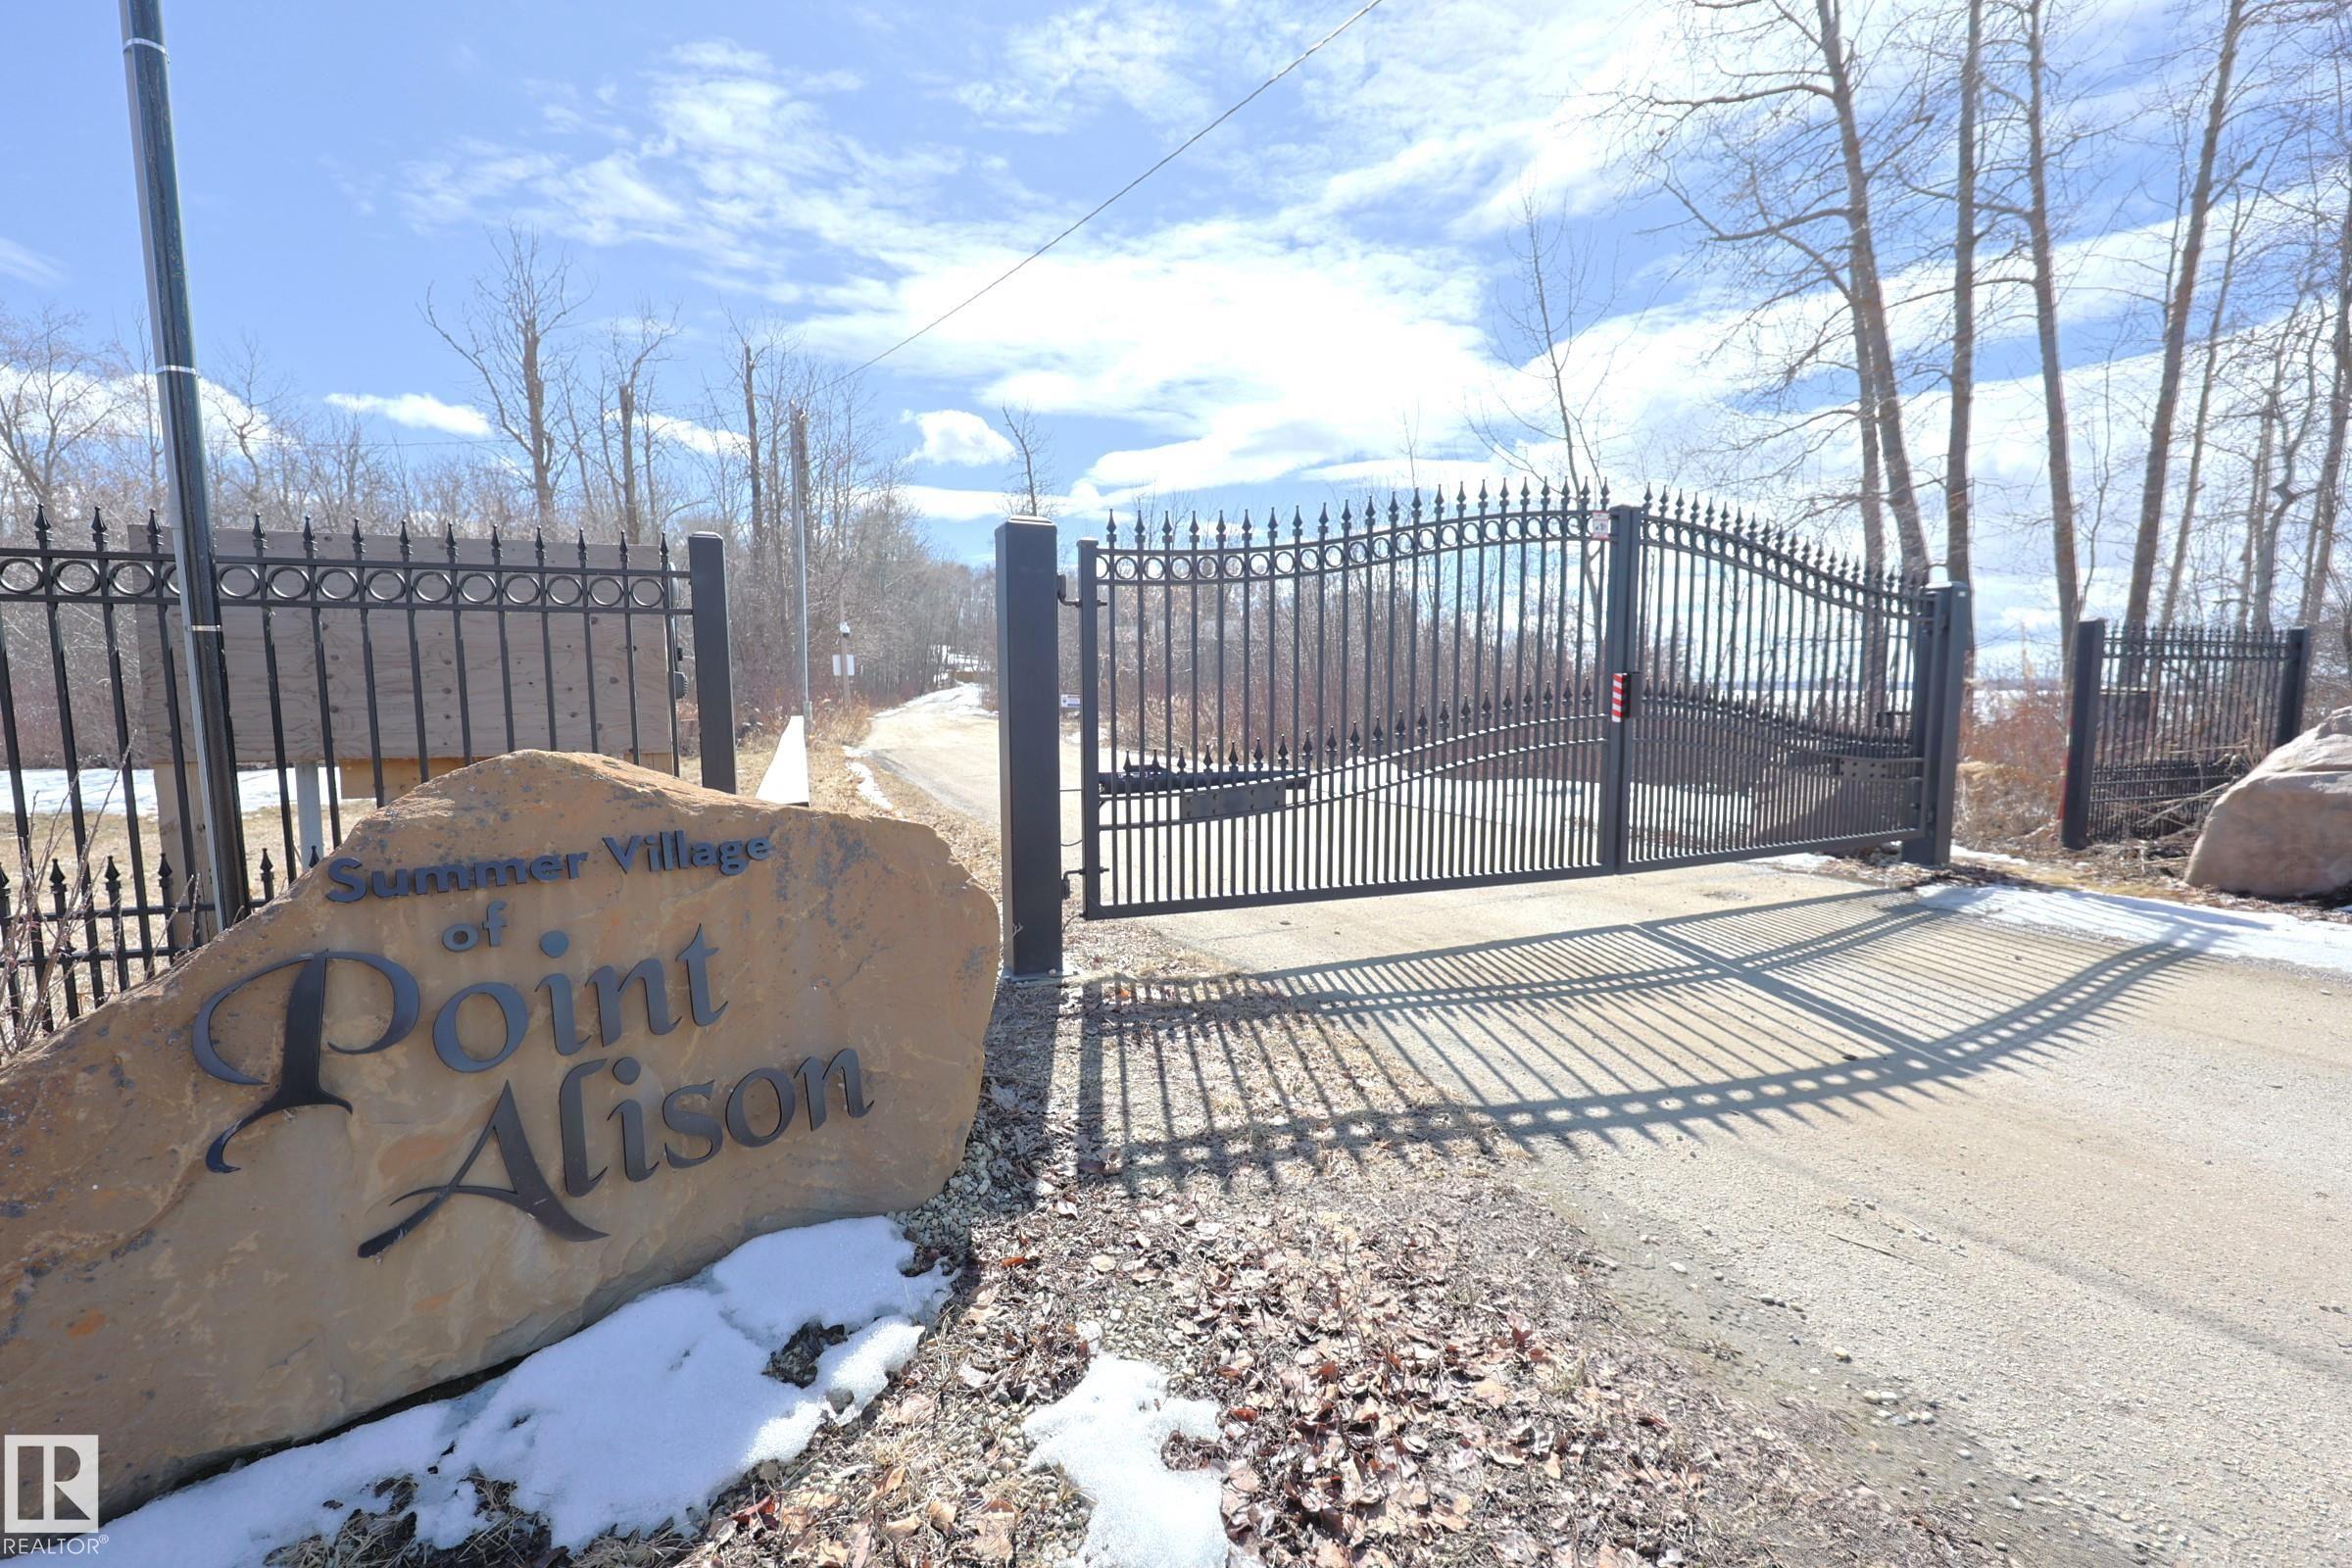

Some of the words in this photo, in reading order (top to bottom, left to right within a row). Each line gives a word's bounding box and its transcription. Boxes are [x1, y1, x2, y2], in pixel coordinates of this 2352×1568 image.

[325, 850, 588, 904] Summer
[602, 829, 773, 877] Village
[442, 899, 509, 954] of
[192, 923, 729, 1174] Point
[357, 1048, 875, 1259] Alison
